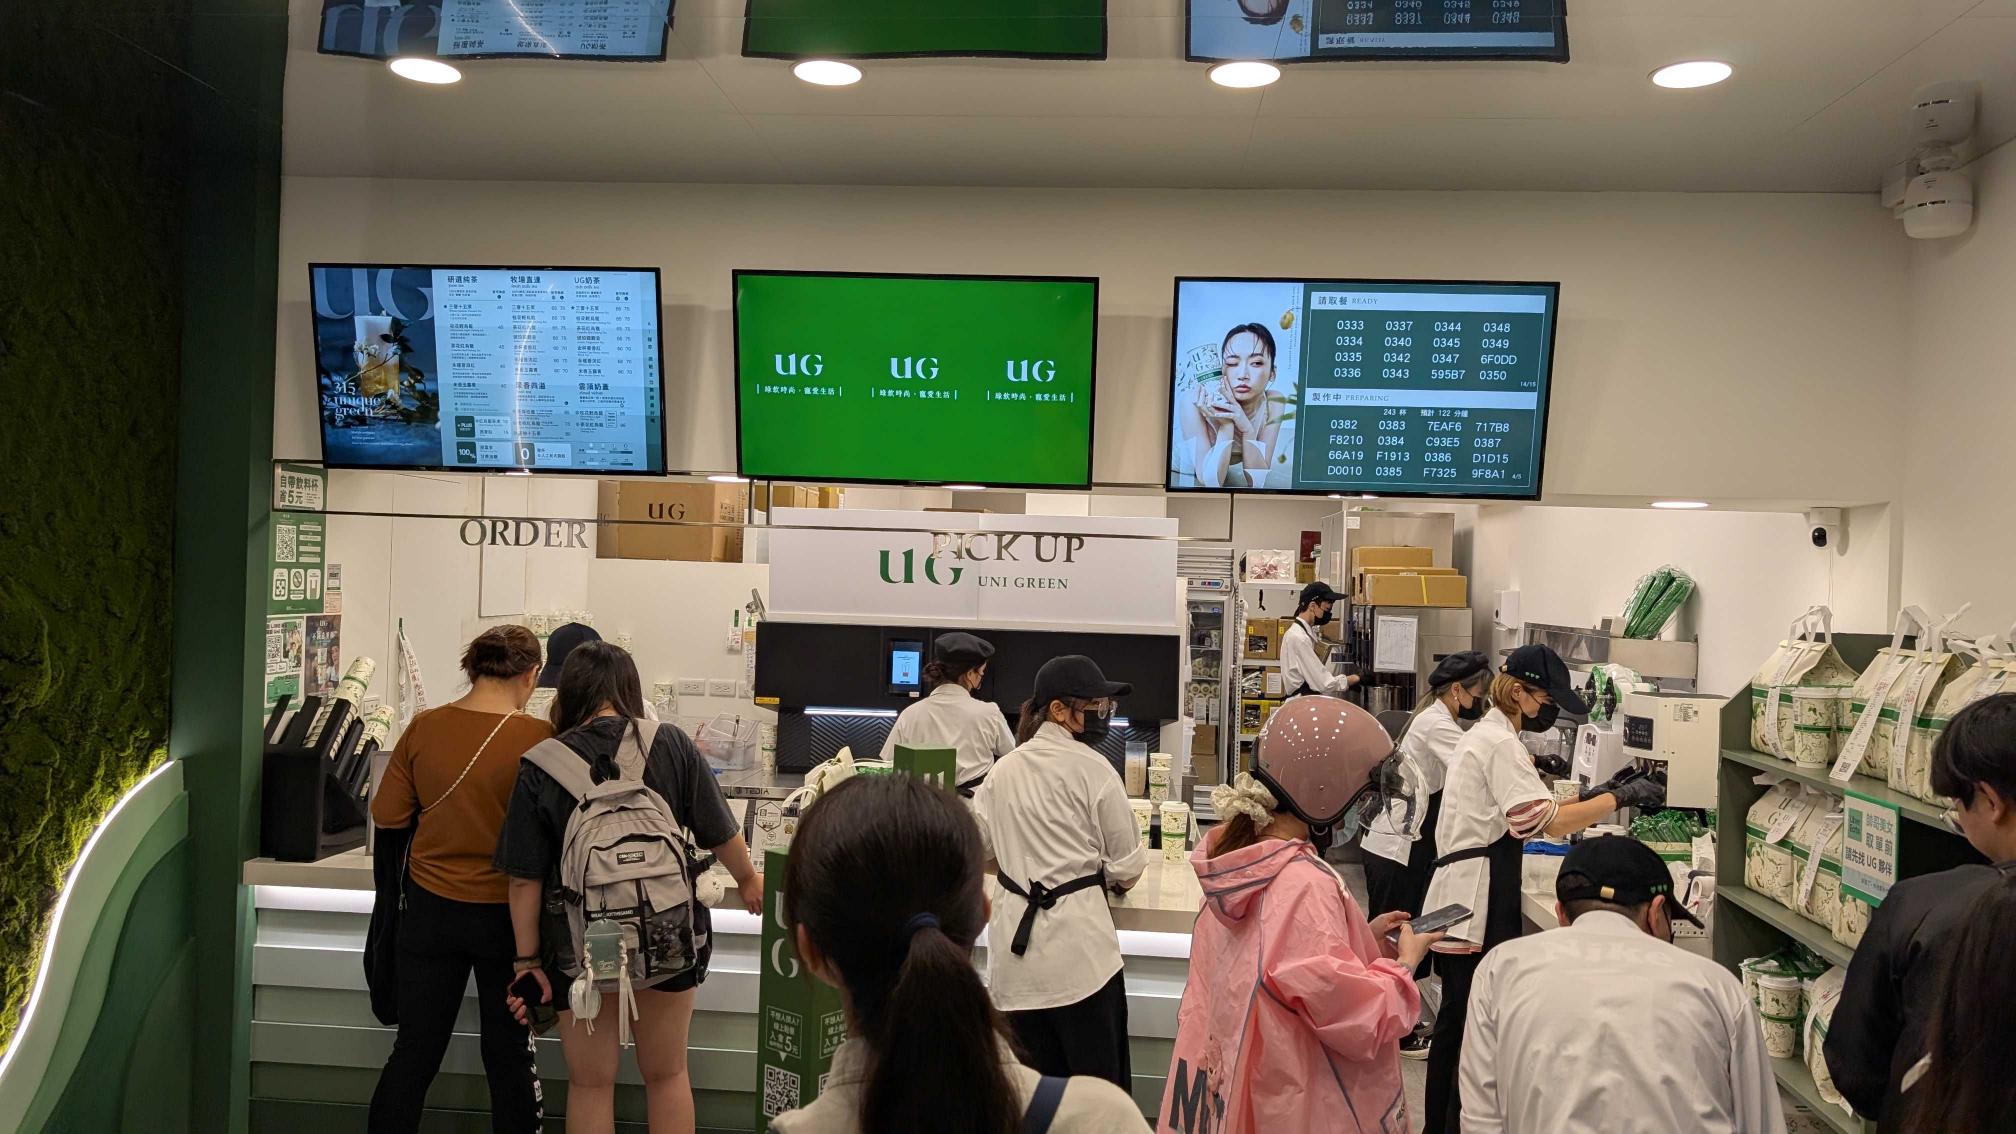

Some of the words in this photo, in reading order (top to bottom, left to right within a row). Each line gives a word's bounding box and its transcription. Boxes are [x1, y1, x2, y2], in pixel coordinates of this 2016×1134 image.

[1318, 296, 1348, 305] 請取餐
[1337, 321, 1364, 330] 0333
[1386, 321, 1413, 331] 0337
[1434, 322, 1461, 332] 0344
[1483, 323, 1510, 333] 0348
[1336, 337, 1363, 346] 0334
[1384, 338, 1412, 347] 0340
[1433, 338, 1460, 348] 0345
[1482, 339, 1509, 348] 0349
[1335, 353, 1362, 362] 0335
[1383, 354, 1410, 362] 0342
[1432, 354, 1459, 364] 0347
[1480, 355, 1517, 364] 6F0DD
[1334, 368, 1361, 378] 0336
[1382, 369, 1409, 378] 0343
[1431, 370, 1465, 379] 595B7
[1479, 371, 1506, 380] 0350
[1312, 392, 1342, 402] 製作中
[333, 397, 381, 412] unique
[335, 408, 373, 426] green
[1330, 420, 1358, 429] 0382
[1379, 421, 1406, 430] 0383
[1427, 422, 1462, 432] 7EAF6
[1476, 423, 1510, 432] 717B8
[1329, 436, 1363, 445] F8210
[1378, 437, 1404, 446] 0384
[1426, 437, 1460, 447] C93E5
[1474, 439, 1501, 448] 0387
[1328, 451, 1363, 461] 66A19
[1376, 452, 1410, 462] F1913
[1424, 453, 1451, 462] 0386
[1472, 454, 1508, 464] D1D15
[1327, 466, 1362, 476] D0010
[1375, 467, 1402, 476] 0385
[1423, 468, 1456, 478] F7325
[1472, 470, 1505, 479] 9F8A1
[281, 474, 318, 491] 自帶飲料杯
[459, 518, 588, 549] ORDER
[930, 532, 1021, 561] PICK
[1033, 535, 1084, 563] UP
[978, 576, 1007, 587] UNI
[1014, 578, 1068, 589] GREEN
[1845, 846, 1866, 867] 請先找
[1866, 854, 1877, 869] UG
